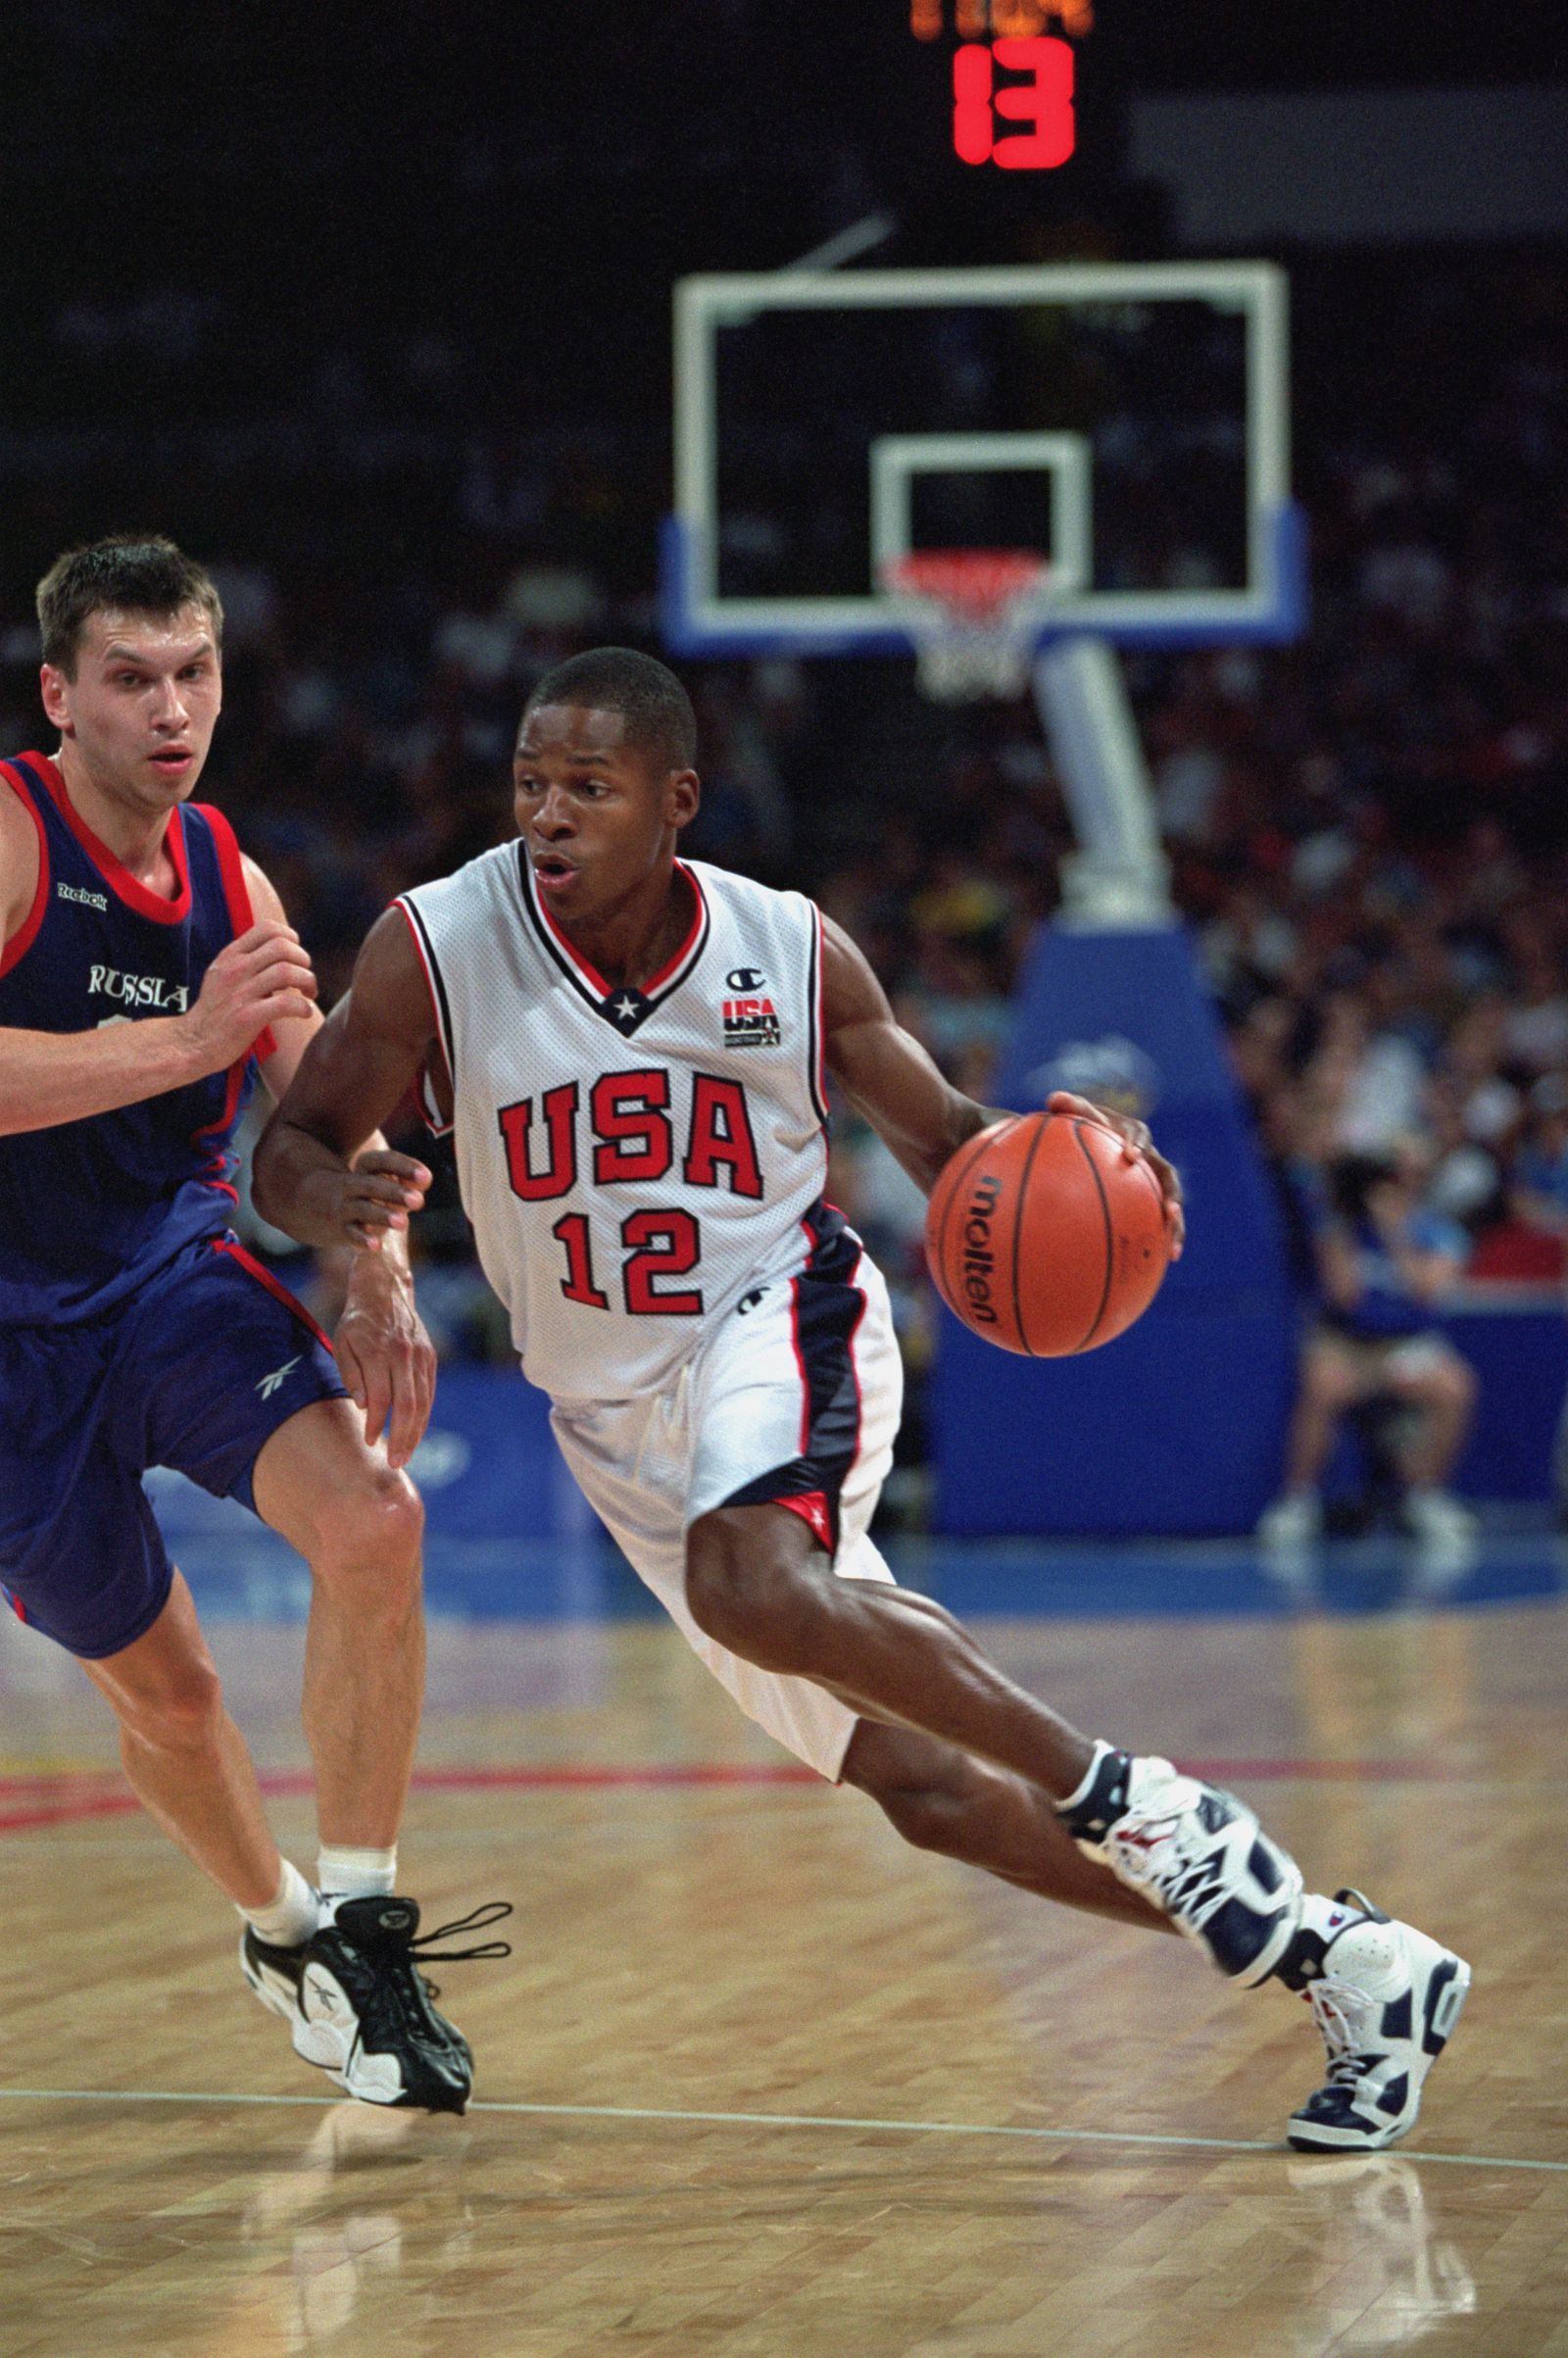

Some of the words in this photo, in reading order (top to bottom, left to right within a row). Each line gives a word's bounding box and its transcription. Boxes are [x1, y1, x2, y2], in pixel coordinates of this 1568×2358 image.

[954, 36, 1075, 169] 13
[57, 882, 108, 911] Reebok
[87, 964, 190, 1012] RUSSIA
[722, 998, 780, 1032] USA
[497, 1067, 764, 1203] USA
[552, 1207, 704, 1315] 12
[963, 1176, 1004, 1324] molten
